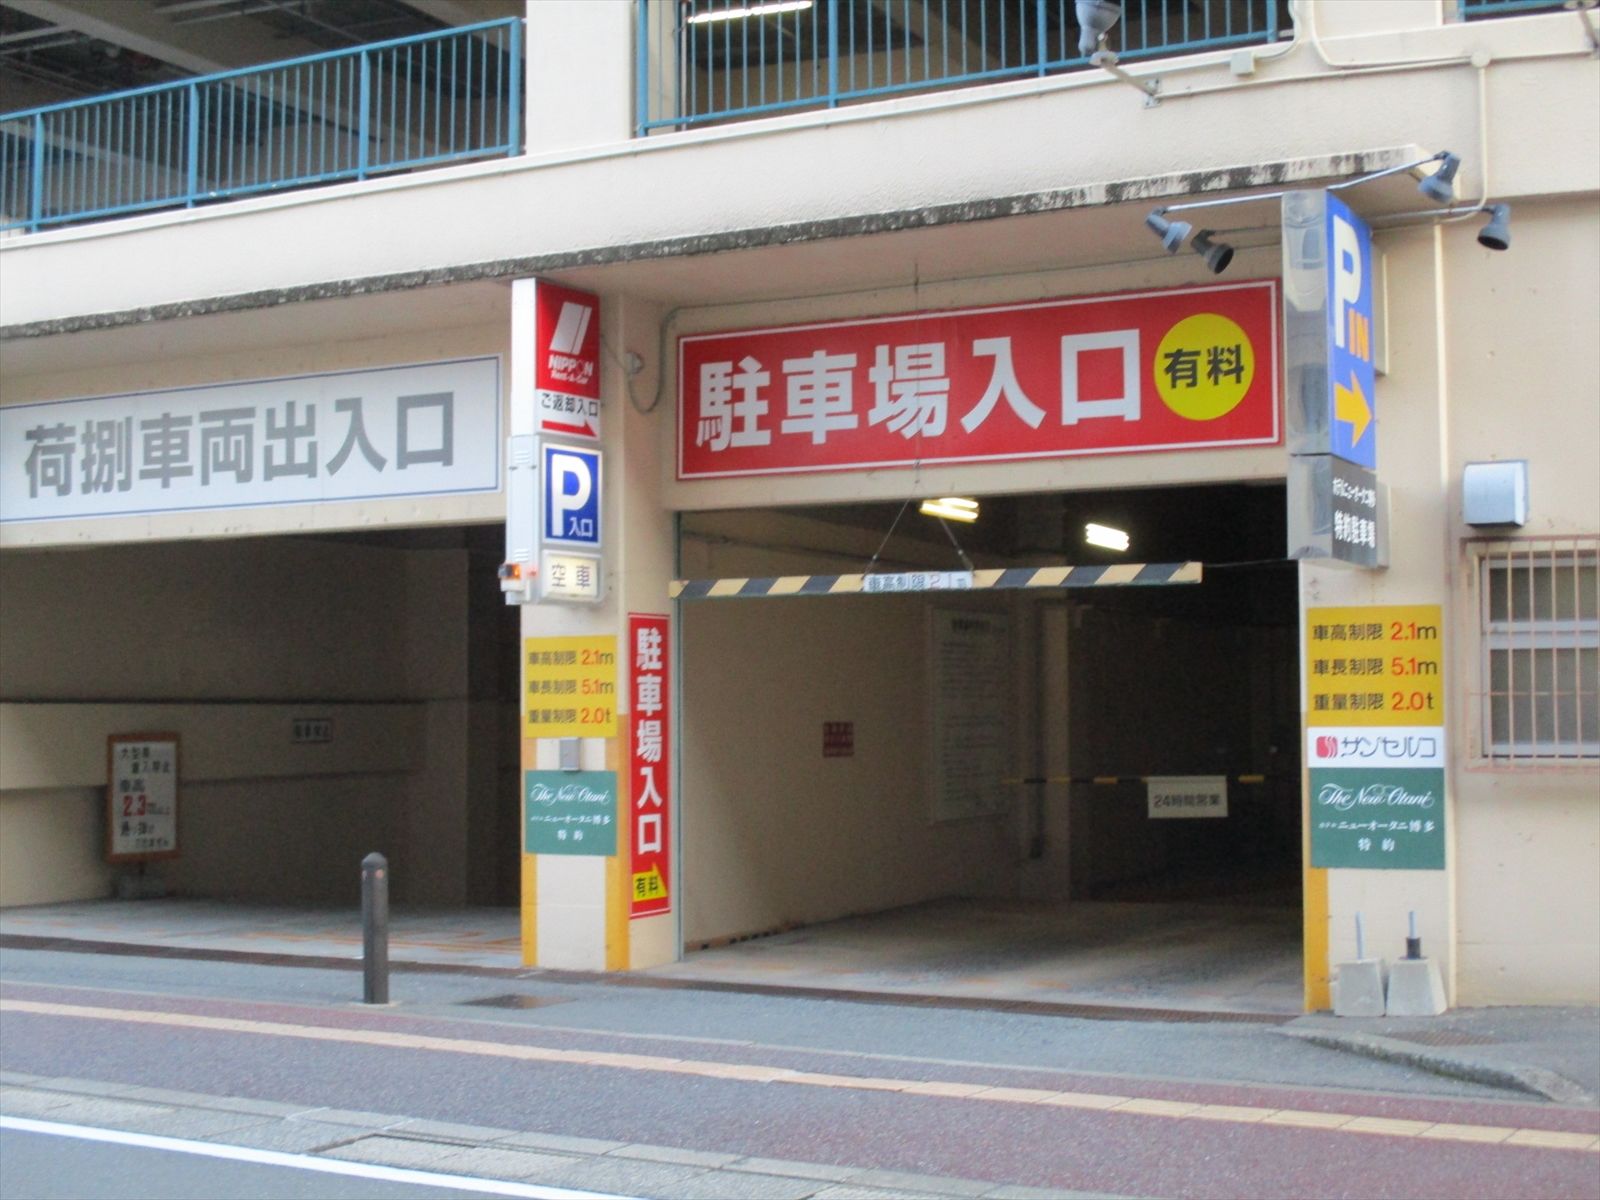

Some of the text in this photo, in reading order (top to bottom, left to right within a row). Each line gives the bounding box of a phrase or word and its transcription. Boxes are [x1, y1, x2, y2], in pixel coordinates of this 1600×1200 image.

[1333, 214, 1361, 348] P
[548, 354, 594, 377] NIPPON
[1164, 343, 1245, 389] 有料
[696, 328, 1141, 452] 駐車場入口
[541, 393, 599, 417] ご返却入口
[24, 391, 454, 498] 荷捌車両出入口
[552, 454, 592, 537] P
[569, 517, 593, 538] 入口
[1313, 621, 1437, 641] 車高制限 2.1m
[581, 649, 614, 665] 2.1m
[1313, 656, 1438, 676] 車長制限 5.1m
[581, 678, 614, 694] 5.1m
[1313, 691, 1434, 711] 重量制限 2.0t
[580, 706, 611, 724] 2.0t
[636, 627, 663, 855] 駐車場入口
[1340, 735, 1437, 758] サンセルコ
[531, 783, 552, 803] The
[545, 784, 577, 806] New
[1318, 782, 1435, 811] The New Otani
[636, 876, 659, 897] 有料
